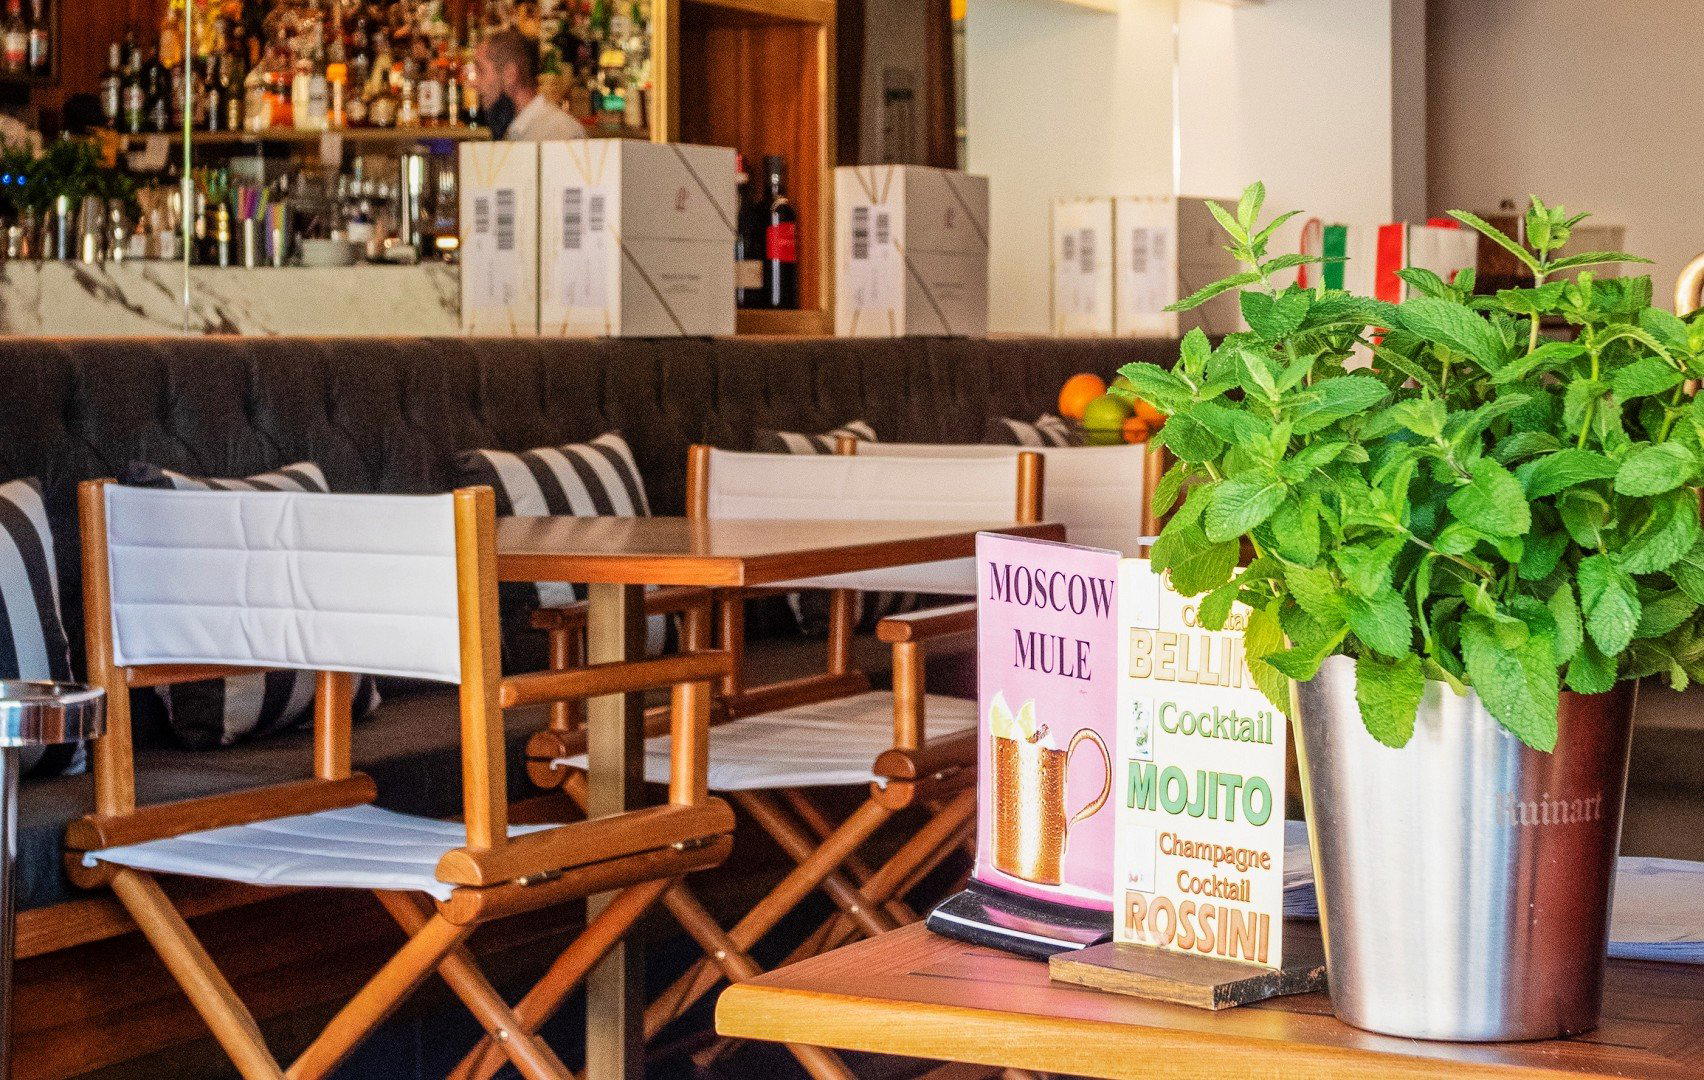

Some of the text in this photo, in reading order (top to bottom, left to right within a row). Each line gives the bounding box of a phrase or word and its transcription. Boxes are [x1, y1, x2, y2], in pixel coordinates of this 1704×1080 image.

[989, 561, 1115, 620] MOSCOW
[1013, 628, 1092, 681] MULE
[1129, 626, 1260, 691] BELLIN
[1158, 701, 1273, 745] Cocktail
[1127, 761, 1273, 827] MOJITO
[1159, 831, 1271, 873] Champagne
[1176, 869, 1251, 902] Cocktail
[1124, 891, 1270, 964] ROSSINI
